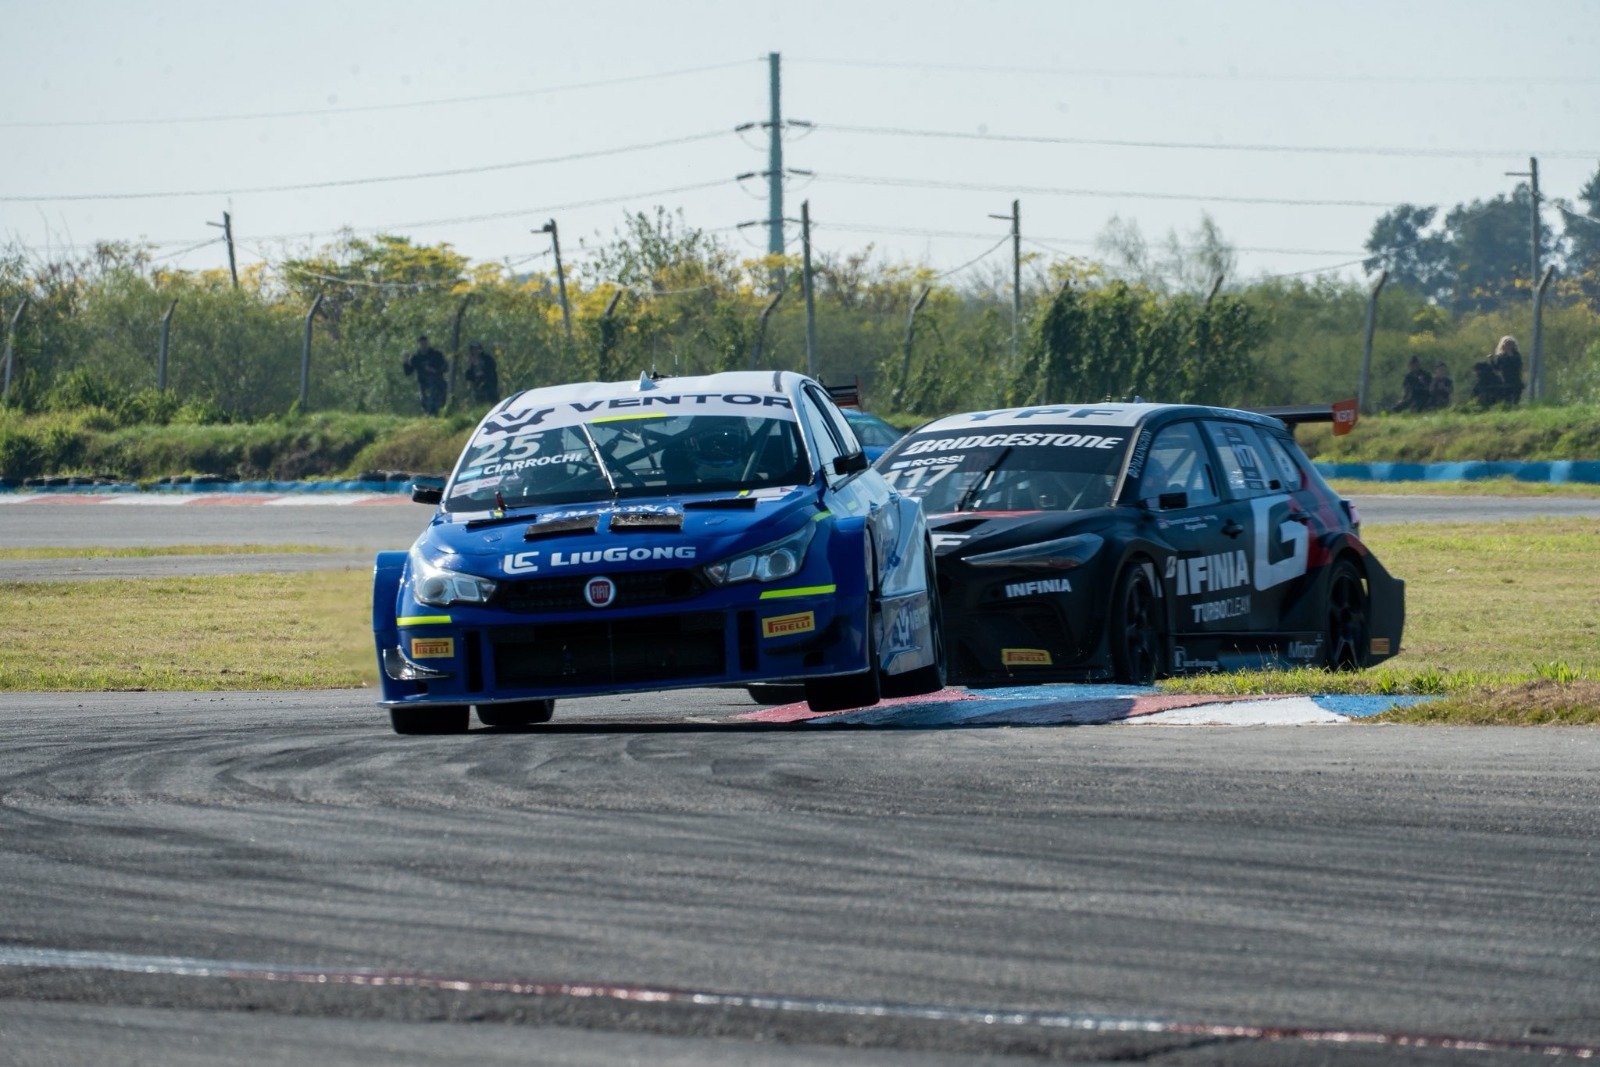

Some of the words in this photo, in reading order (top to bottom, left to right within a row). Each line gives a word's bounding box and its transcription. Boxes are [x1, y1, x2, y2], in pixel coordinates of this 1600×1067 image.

[569, 394, 792, 413] VENTOR
[970, 408, 1123, 422] YPF
[468, 433, 544, 468] 25
[899, 433, 1124, 456] BRIDGESTONE
[483, 453, 582, 475] CIARROCHI
[910, 455, 966, 467] ROSSI
[551, 546, 696, 566] LIUGONG
[591, 585, 609, 600] FIAT
[1005, 578, 1072, 598] INFINIA
[767, 616, 811, 634] PIRELLI
[414, 641, 449, 655] PIRELLI
